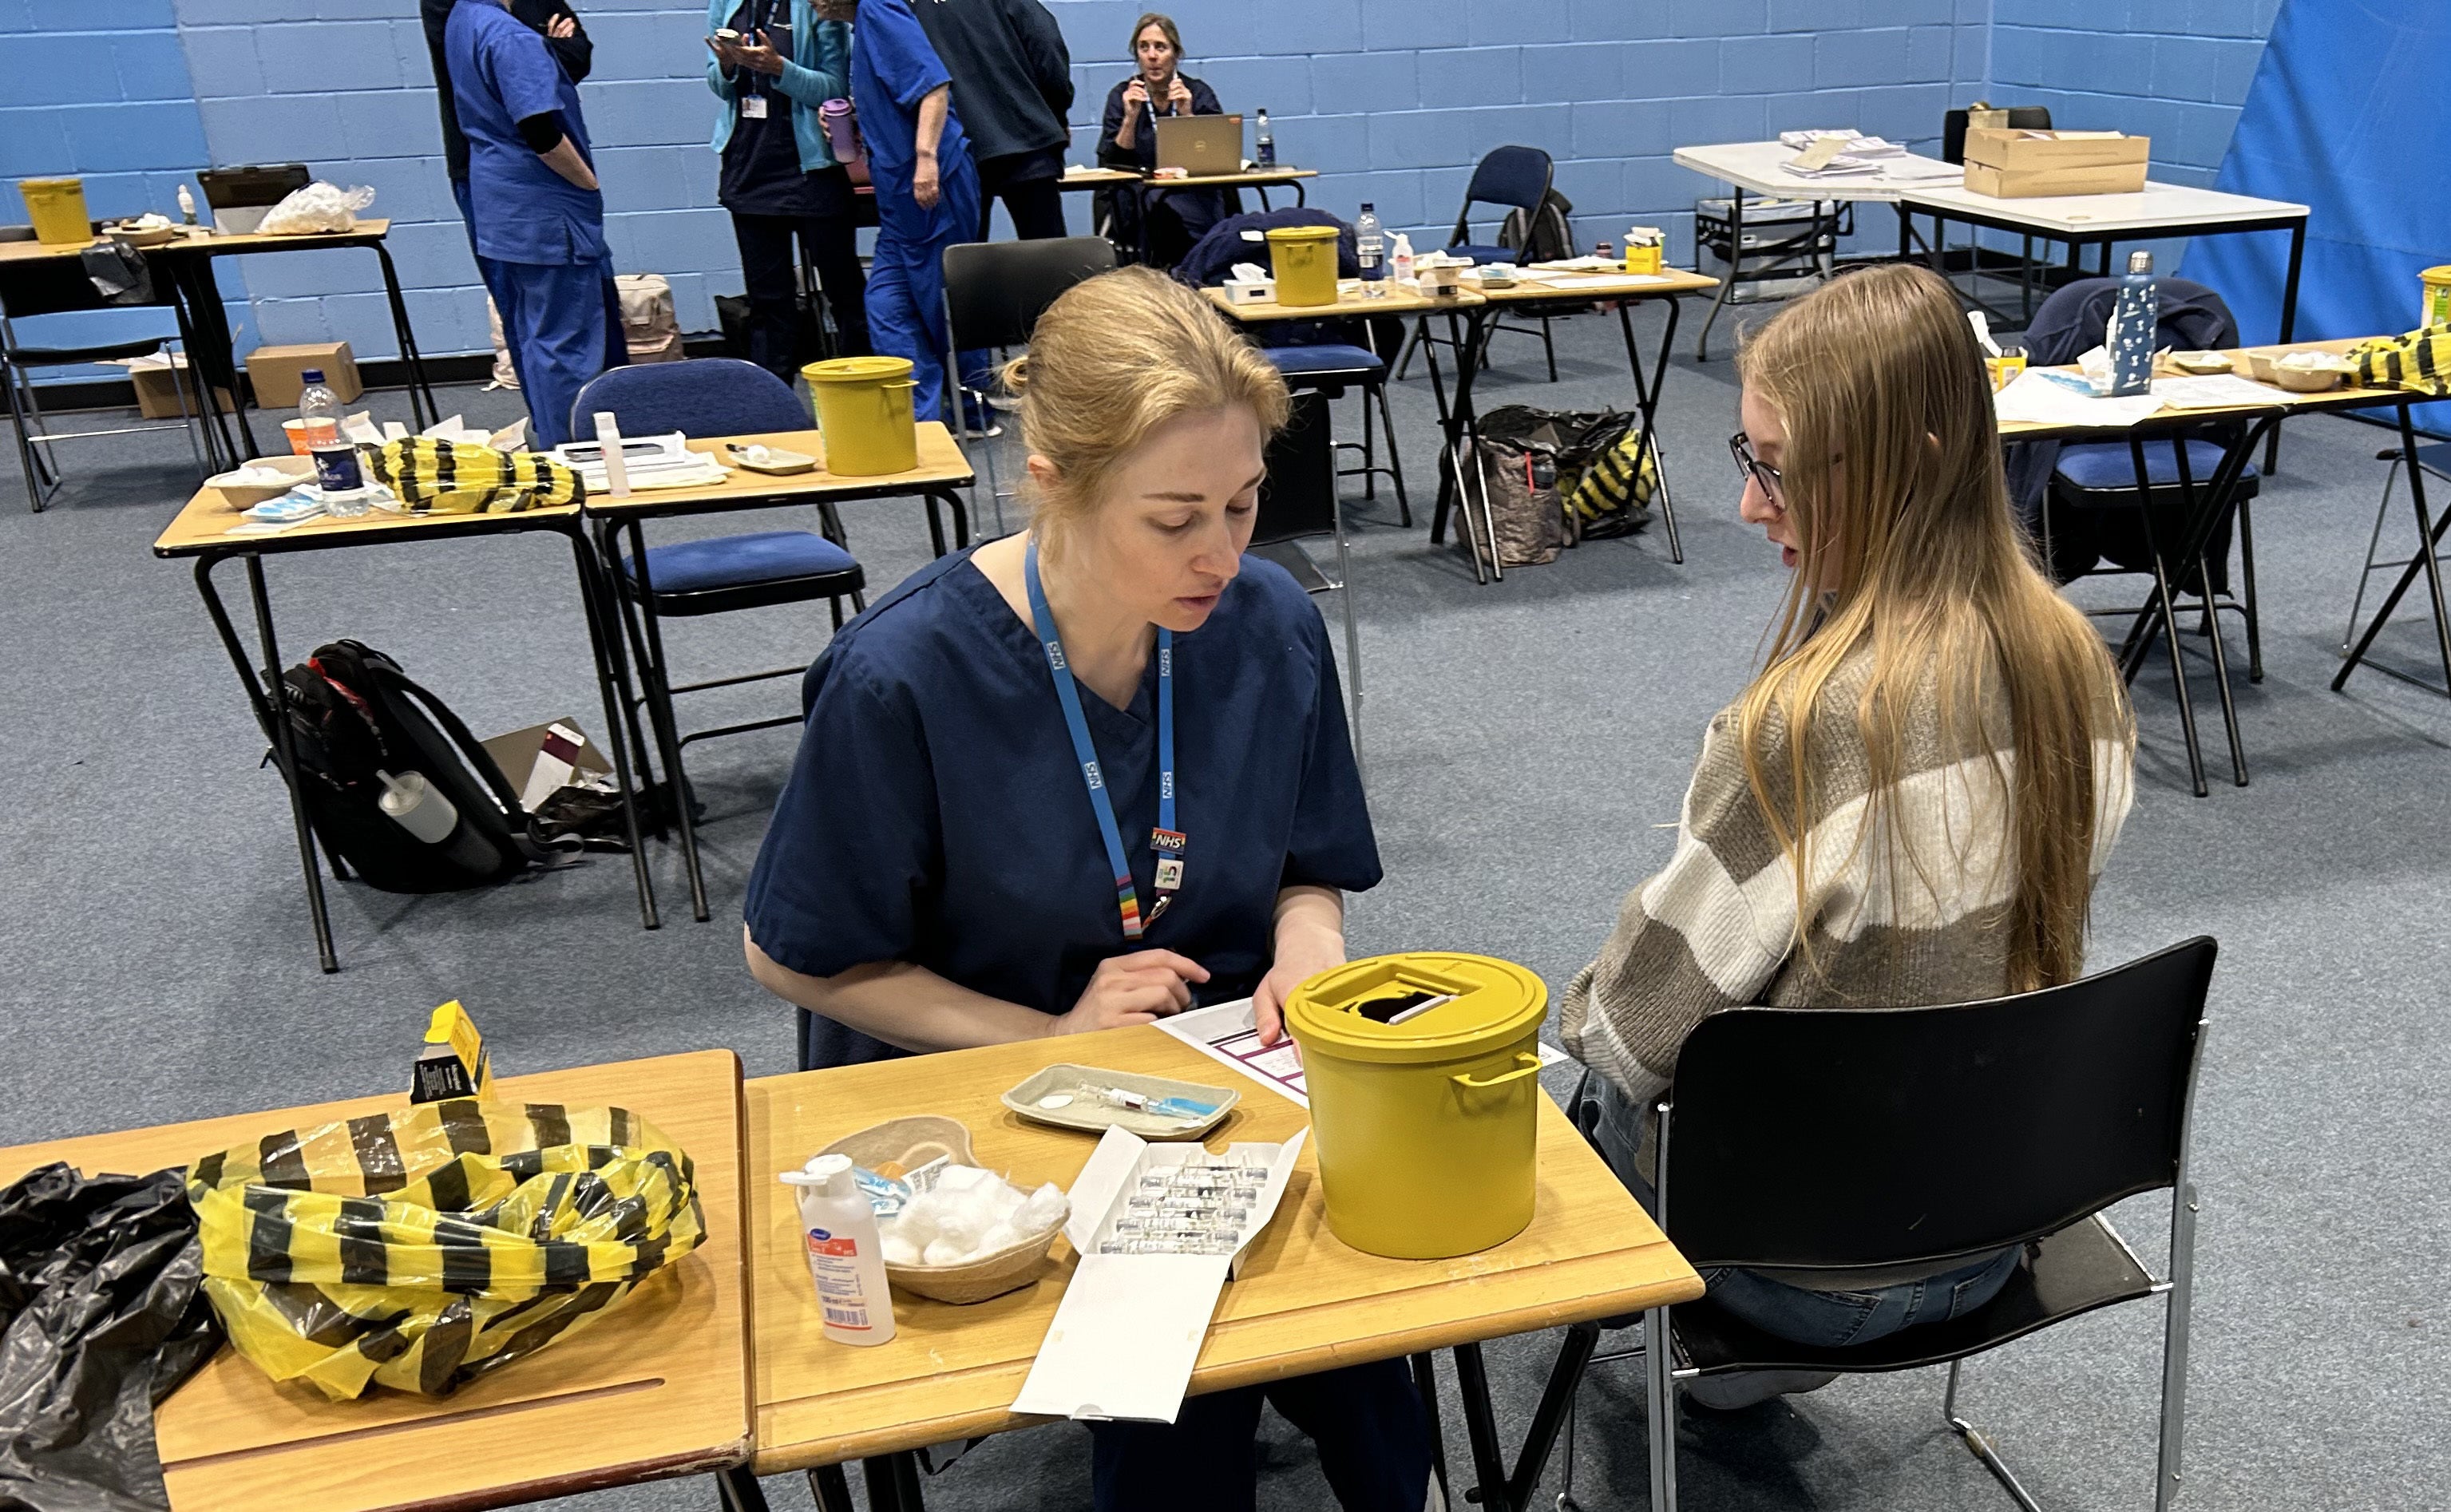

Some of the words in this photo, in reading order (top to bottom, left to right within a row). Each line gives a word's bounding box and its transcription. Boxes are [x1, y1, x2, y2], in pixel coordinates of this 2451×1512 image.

[1047, 643, 1064, 668] NHS
[1085, 763, 1101, 787] NHS
[1162, 774, 1171, 797] NHS
[1155, 834, 1182, 849] NHS
